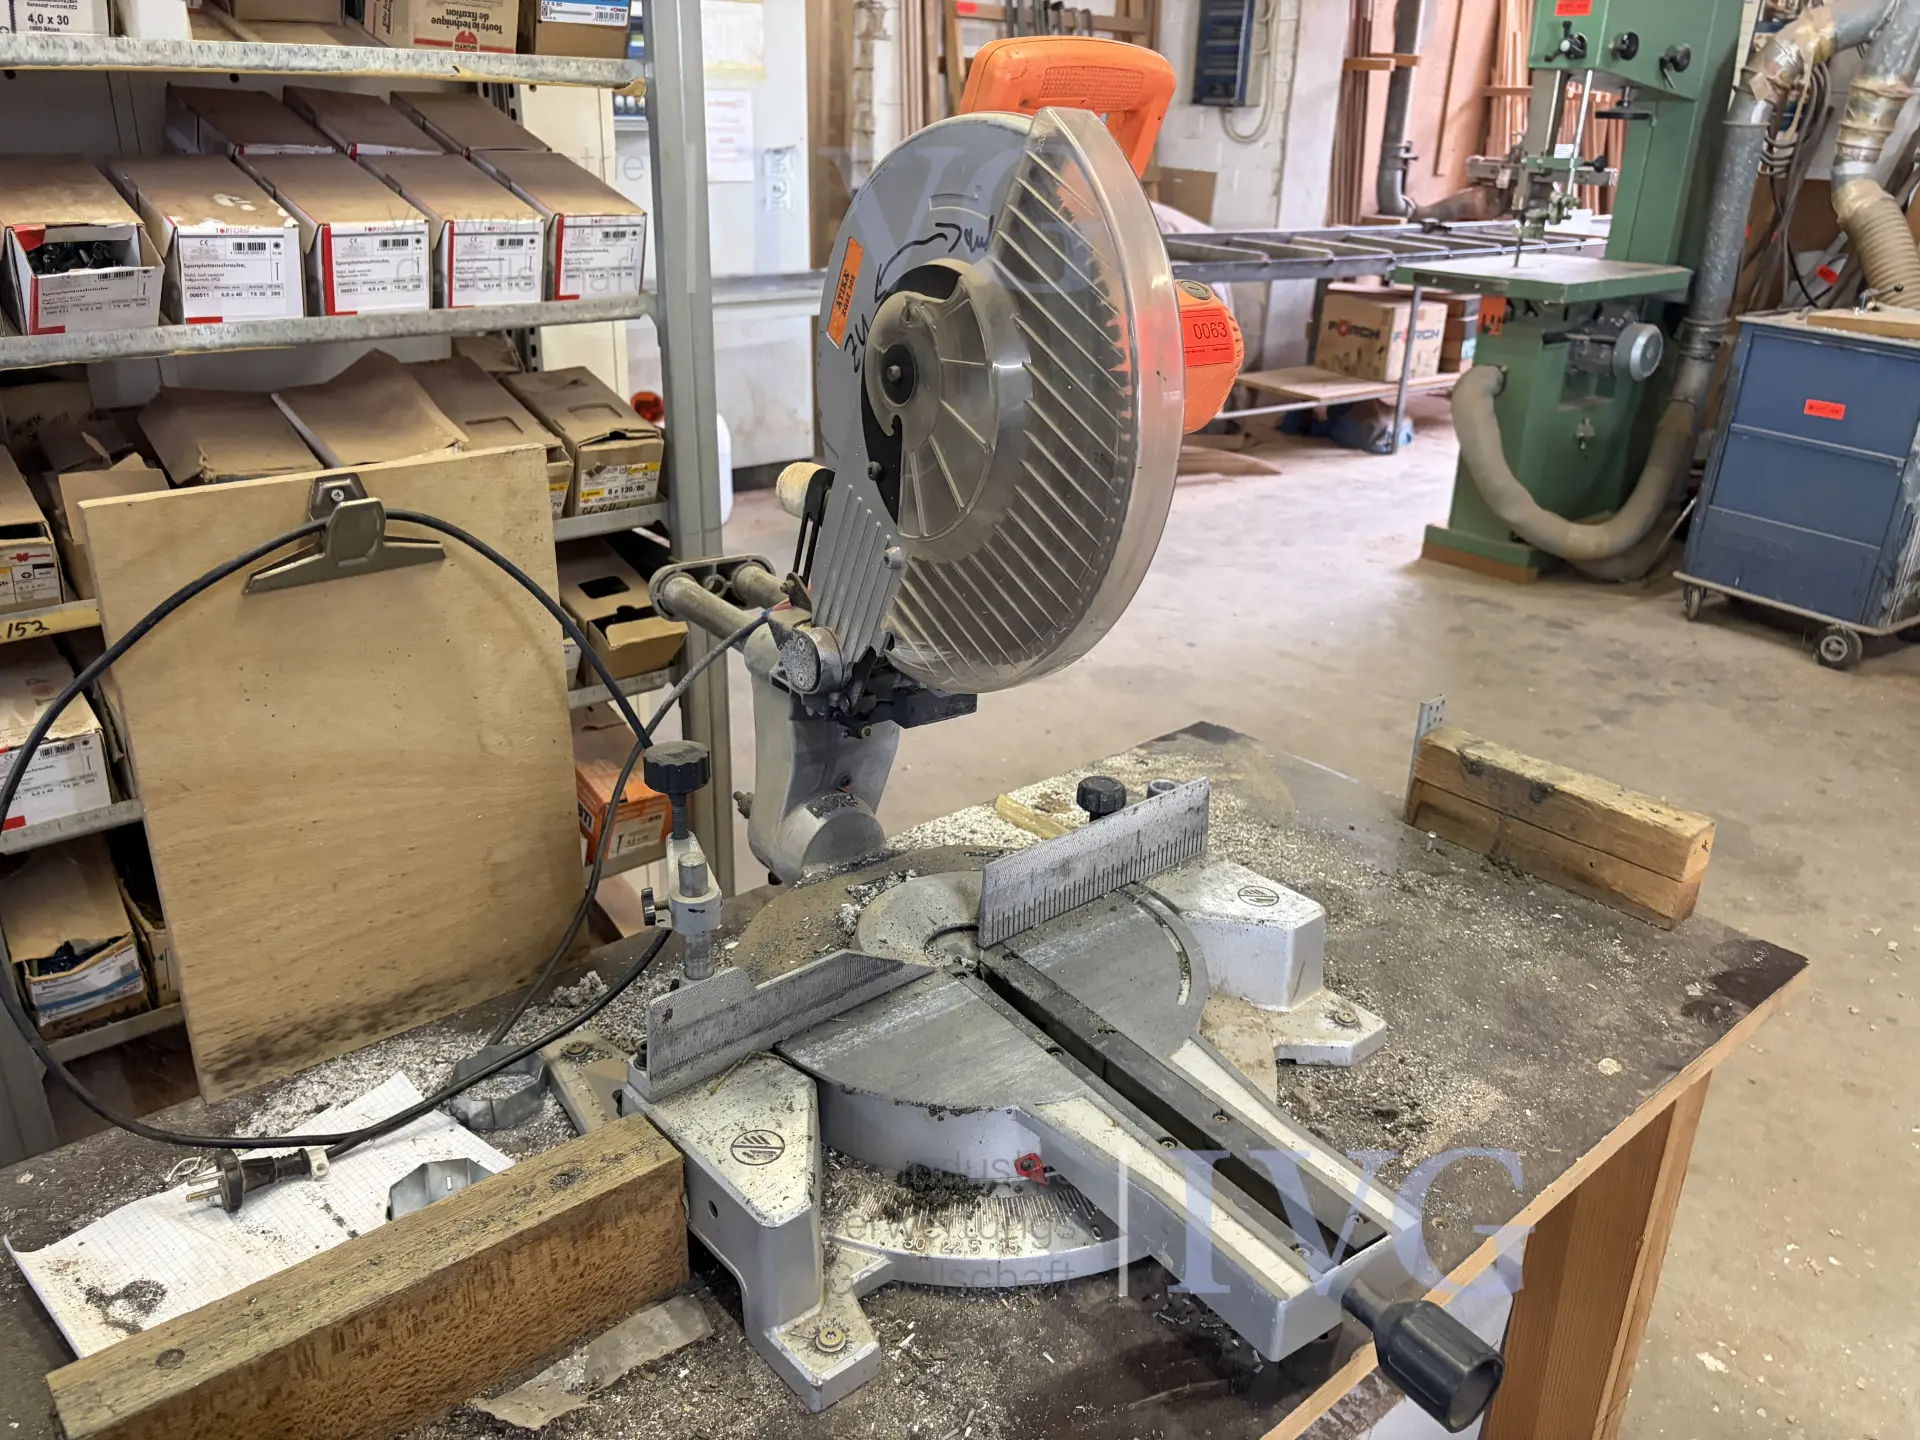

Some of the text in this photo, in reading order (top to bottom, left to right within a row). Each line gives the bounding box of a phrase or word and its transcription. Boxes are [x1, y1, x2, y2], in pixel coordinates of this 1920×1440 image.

[28, 14, 69, 25] 4,0 x 30
[446, 8, 490, 21] de fixation
[431, 17, 503, 35] Toute la technique
[836, 269, 850, 310] ATIKA
[1193, 321, 1228, 340] 0063
